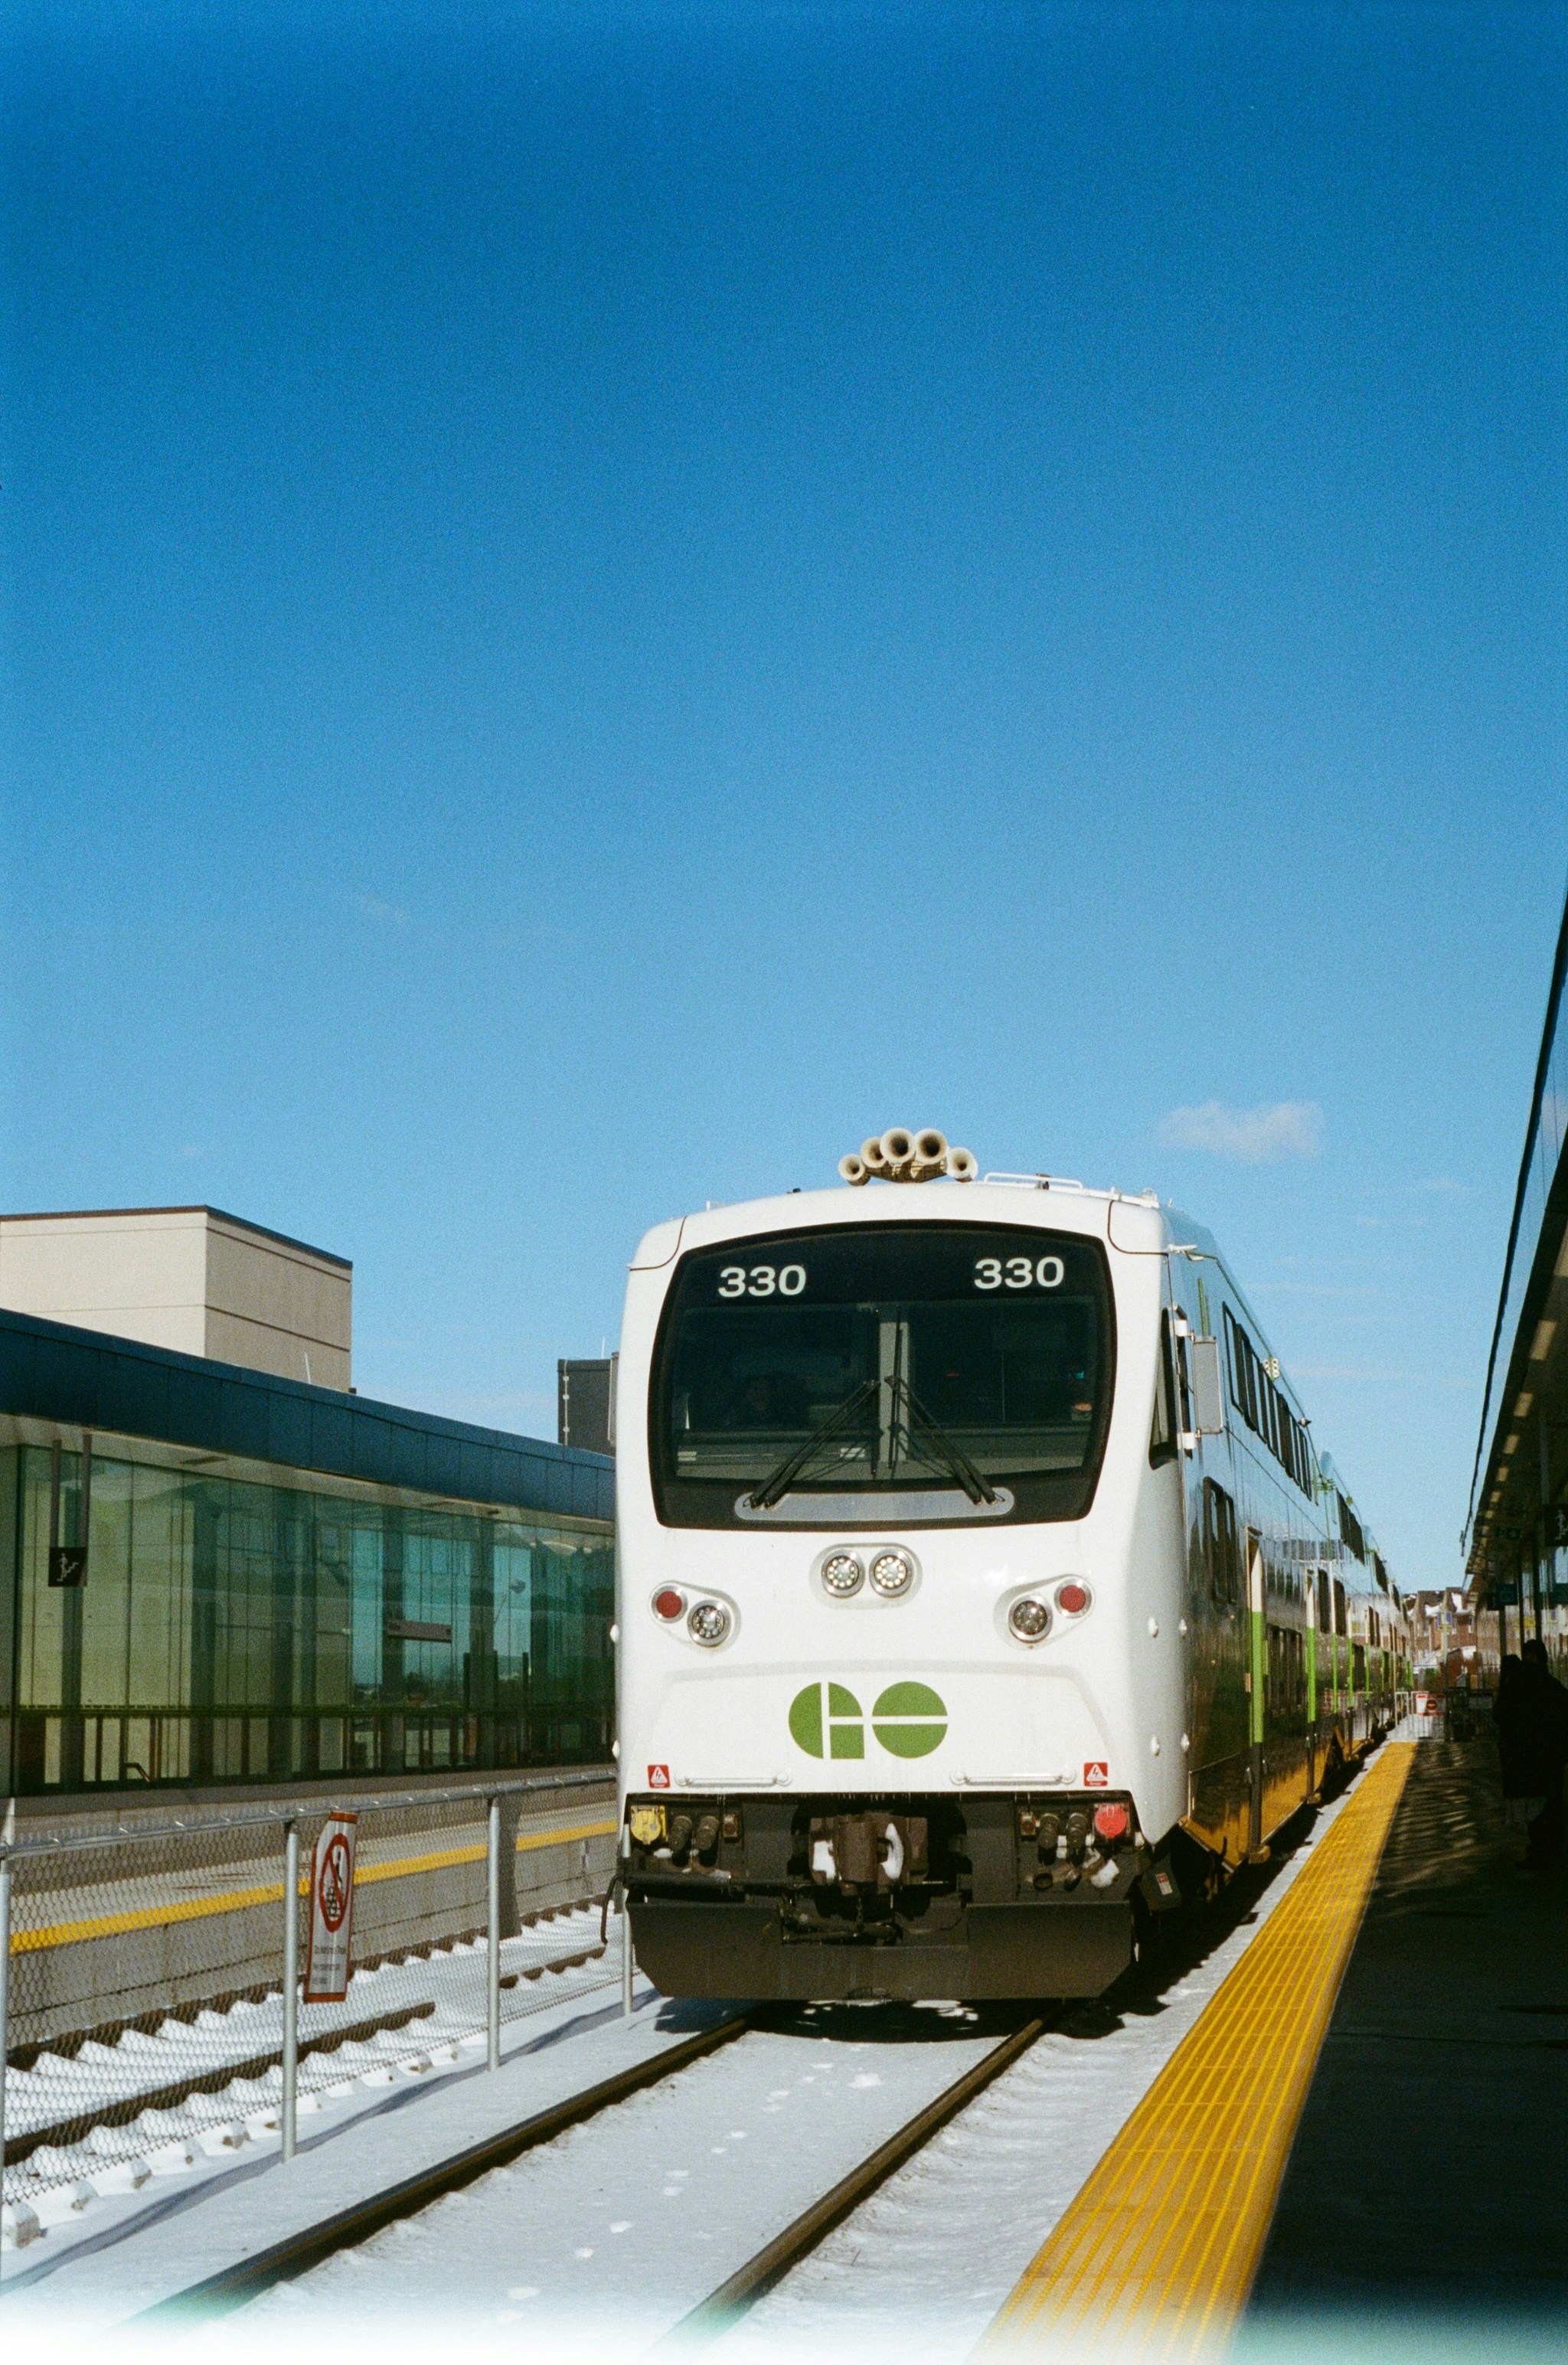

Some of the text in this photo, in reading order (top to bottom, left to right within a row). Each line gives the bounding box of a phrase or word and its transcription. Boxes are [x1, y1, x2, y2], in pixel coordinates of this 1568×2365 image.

[718, 1266, 806, 1298] 330
[974, 1257, 1064, 1289] 330
[789, 1681, 948, 1760] GO
